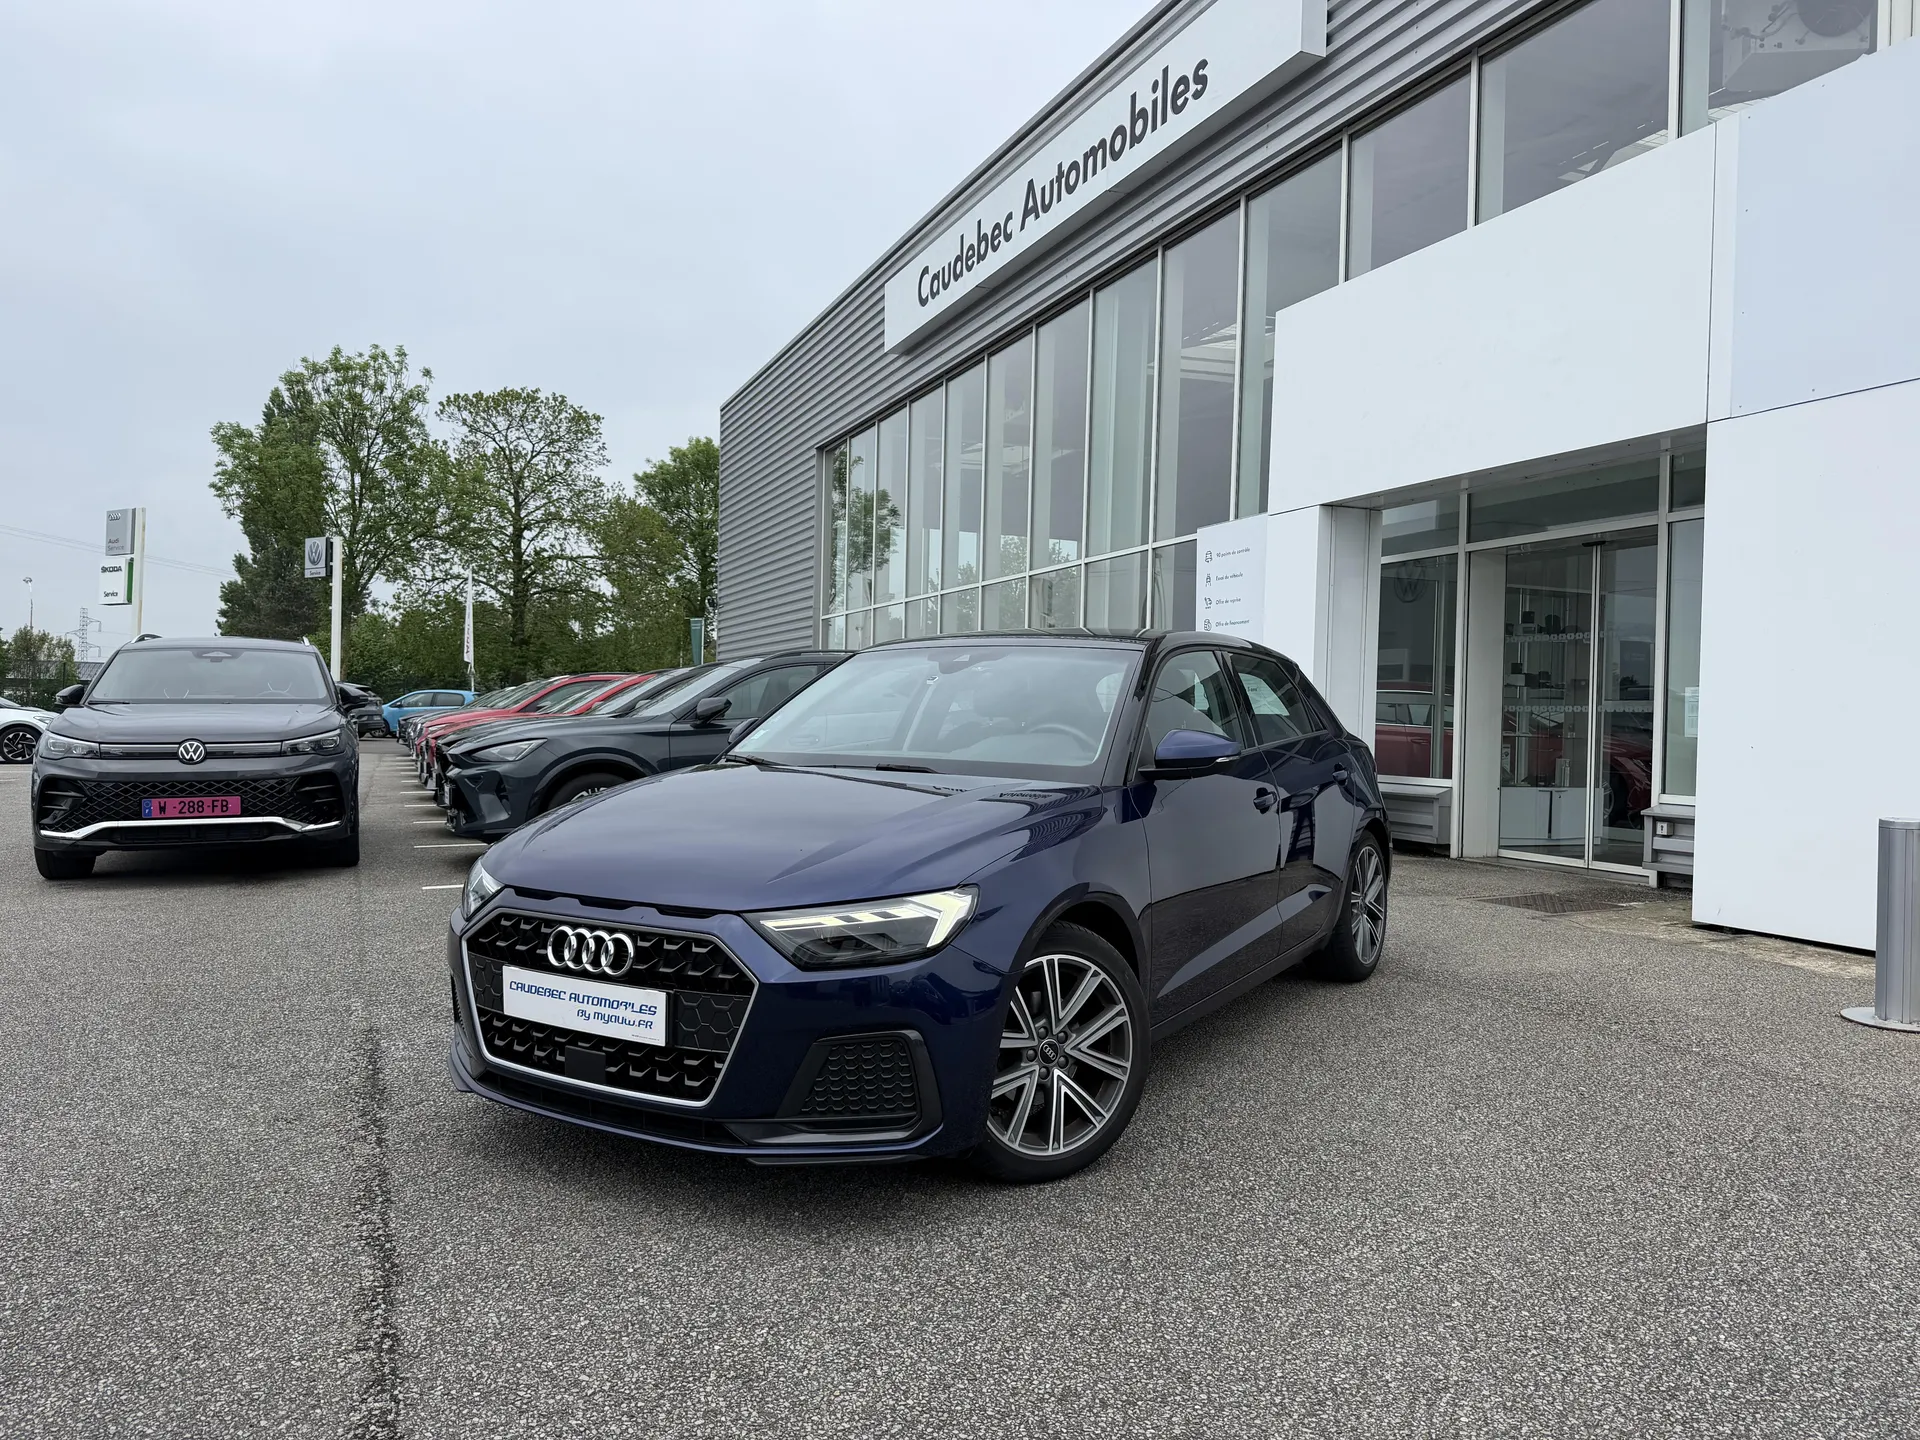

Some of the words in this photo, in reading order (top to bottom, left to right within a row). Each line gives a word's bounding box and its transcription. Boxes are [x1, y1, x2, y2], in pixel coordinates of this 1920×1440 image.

[917, 211, 1013, 308] Caudebec
[1019, 58, 1209, 232] Automobiles
[509, 980, 566, 1001] CAUDEBEC
